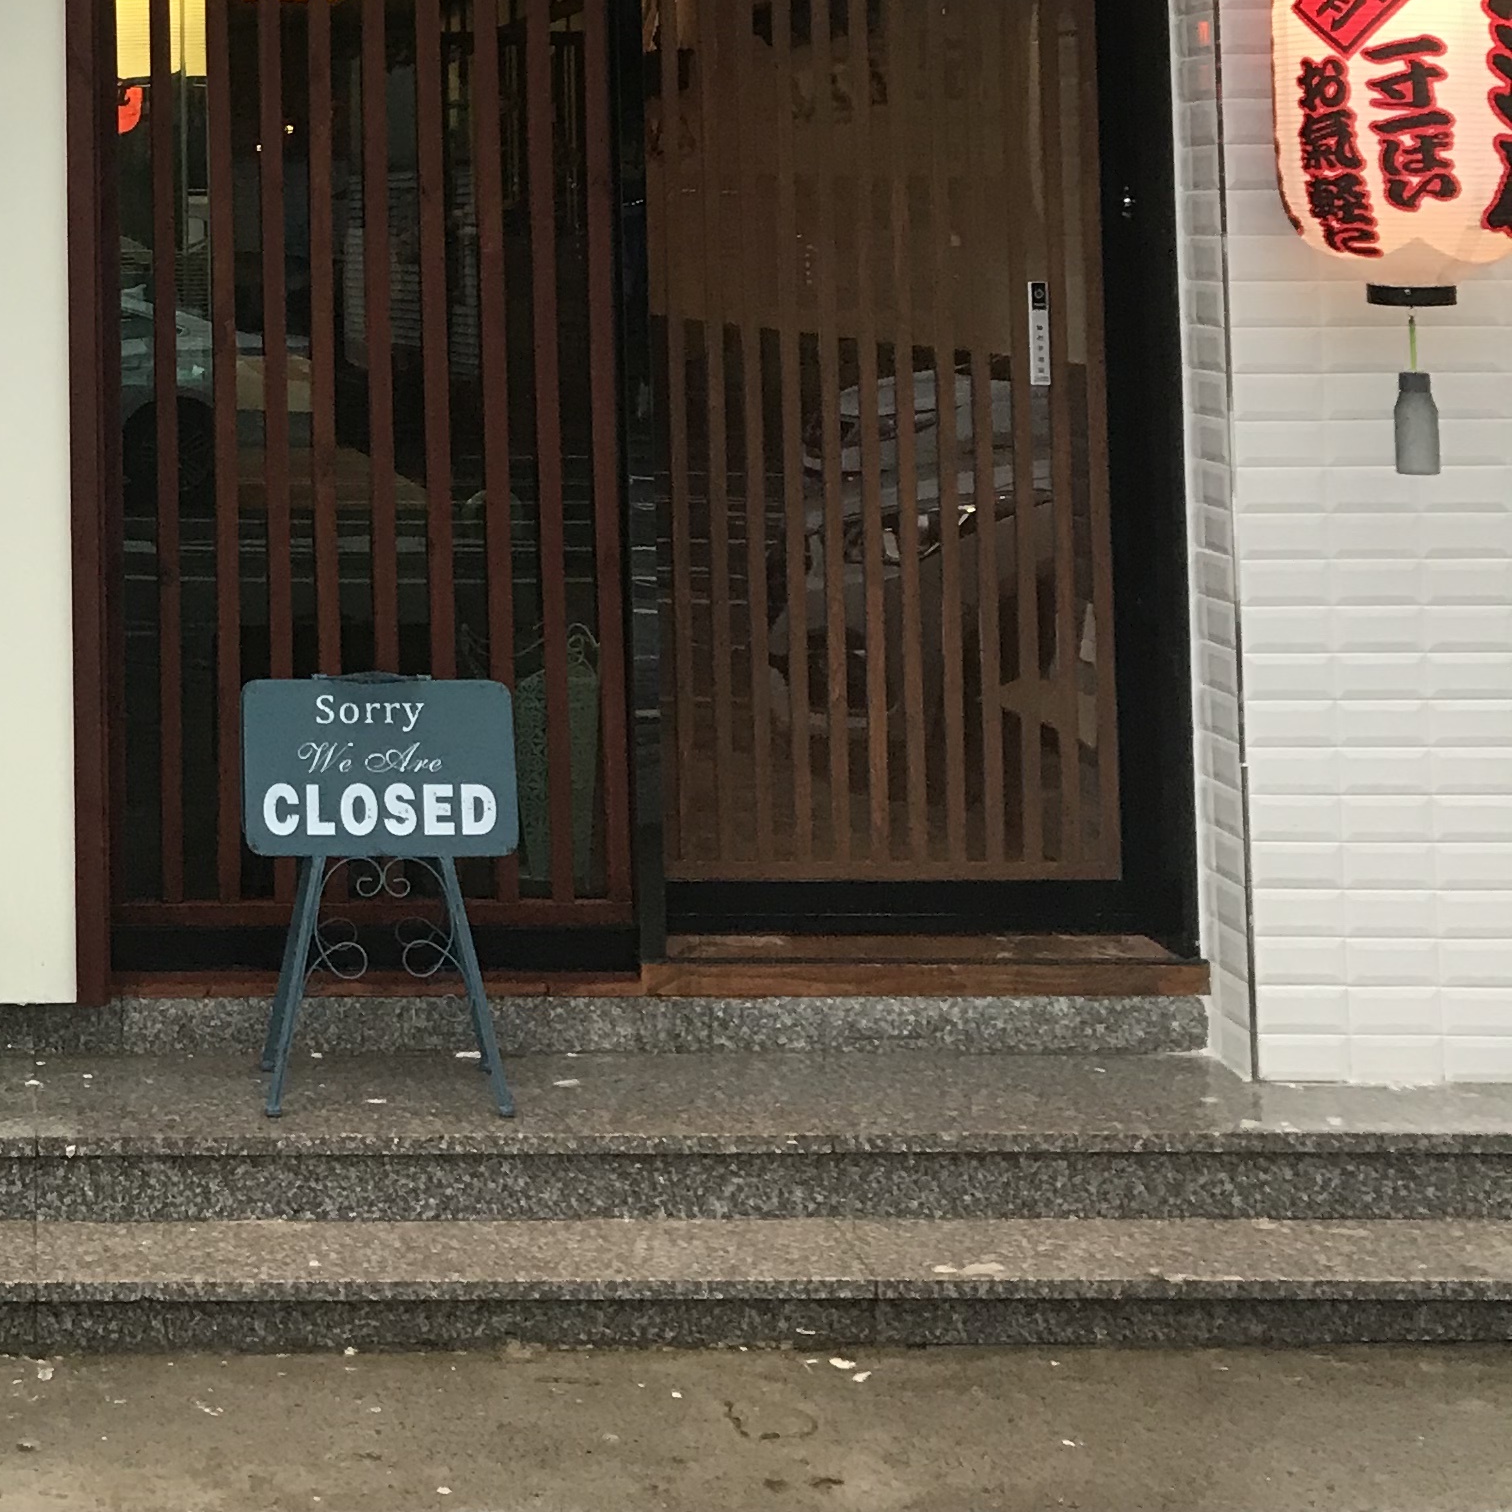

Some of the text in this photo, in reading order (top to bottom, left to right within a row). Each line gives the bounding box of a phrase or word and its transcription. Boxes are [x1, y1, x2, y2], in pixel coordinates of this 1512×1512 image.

[315, 694, 425, 733] Sorry
[297, 741, 444, 774] We Are
[263, 782, 498, 836] CLOSED
